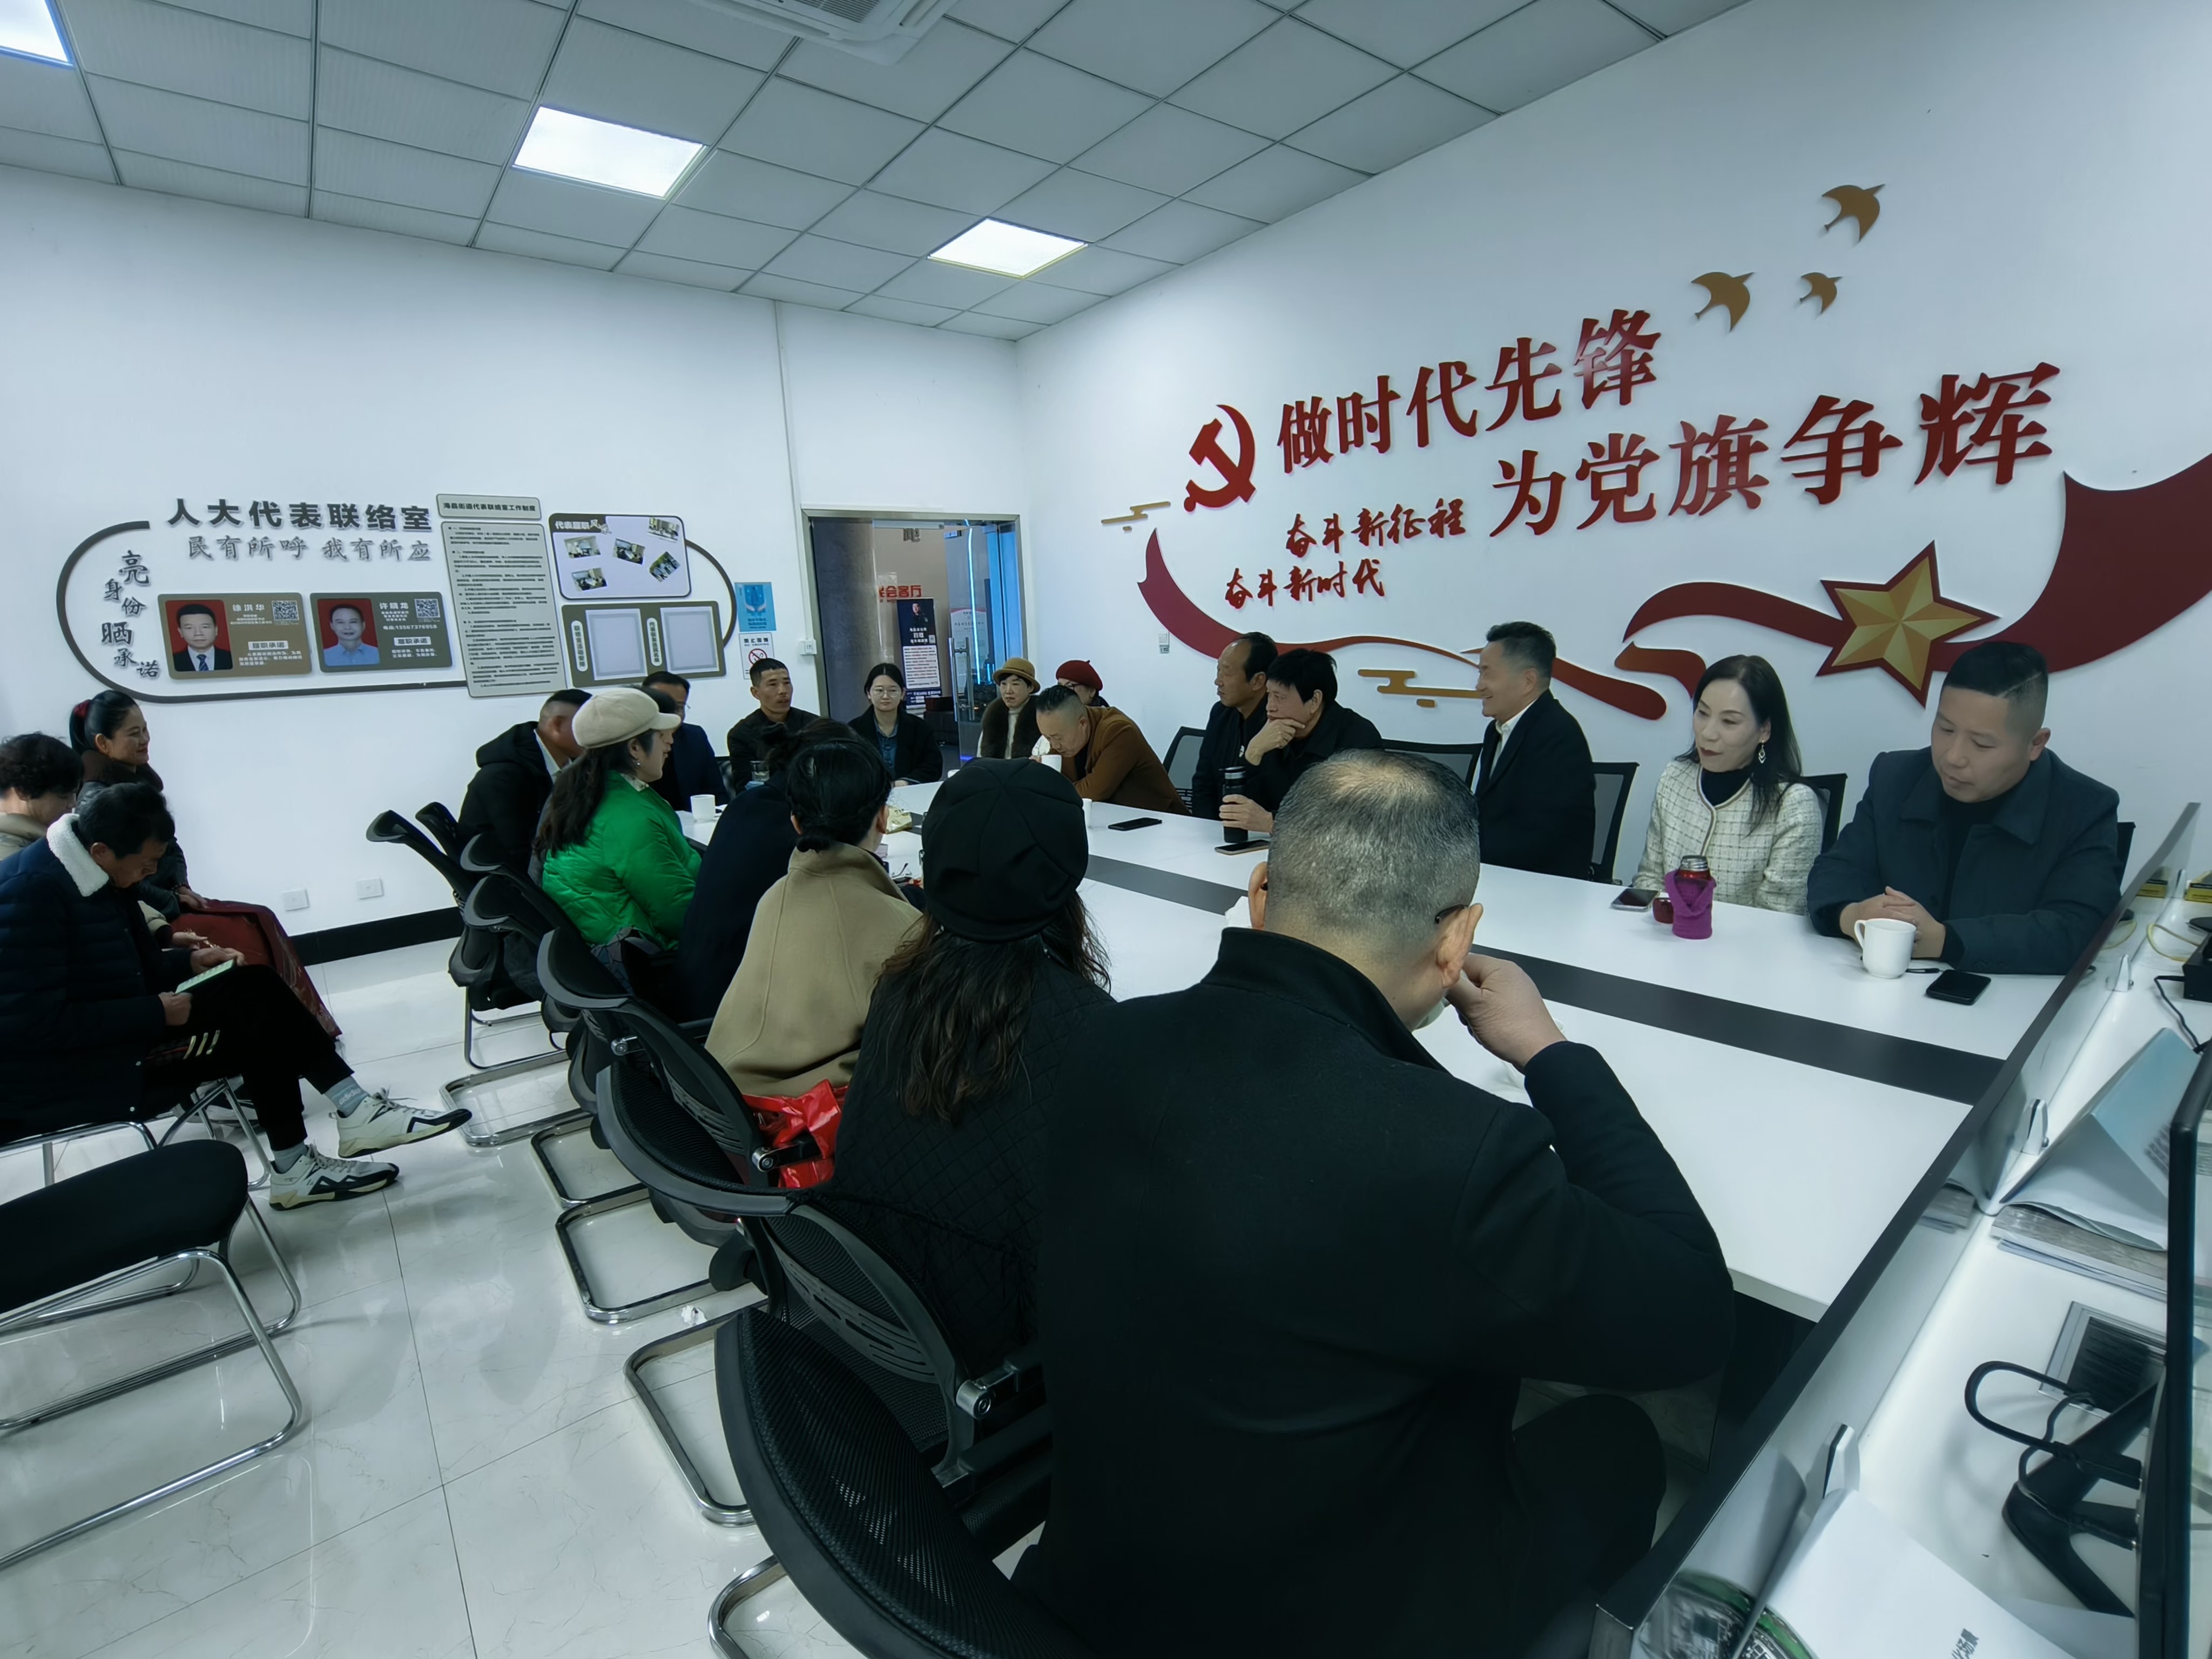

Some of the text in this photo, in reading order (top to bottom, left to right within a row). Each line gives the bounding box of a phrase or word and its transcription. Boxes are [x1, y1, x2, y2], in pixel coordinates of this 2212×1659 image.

[1278, 308, 1662, 474] 做时代先锋
[1489, 361, 2060, 537] 为党旗争辉
[167, 498, 431, 531] 人大代表联络室
[1286, 498, 1466, 558] 奋斗新征程
[188, 535, 431, 561] 民有所呼 我有所应
[104, 550, 150, 615] 亮身份
[1225, 559, 1385, 609] 奋斗新时代
[102, 622, 160, 678] 晒承诺
